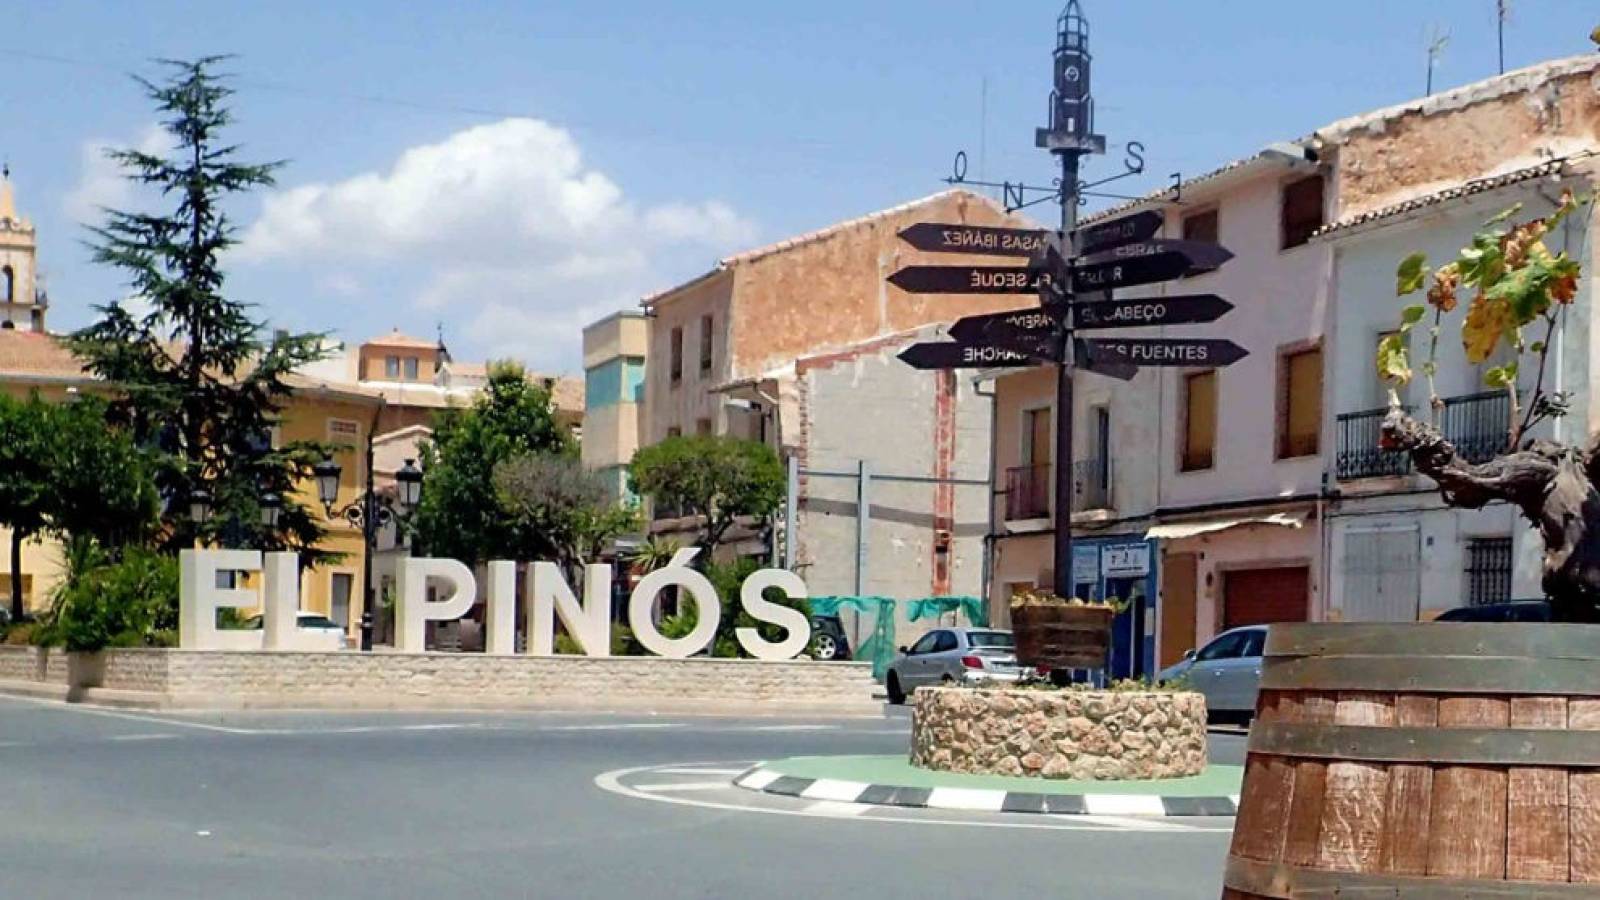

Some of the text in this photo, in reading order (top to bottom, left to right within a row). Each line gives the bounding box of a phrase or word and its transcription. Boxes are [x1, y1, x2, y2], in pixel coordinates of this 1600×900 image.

[954, 151, 968, 182] O
[1124, 141, 1145, 172] S
[1003, 181, 1024, 208] N
[1131, 345, 1208, 360] FUENTES
[180, 547, 811, 660] EL PINÓS
